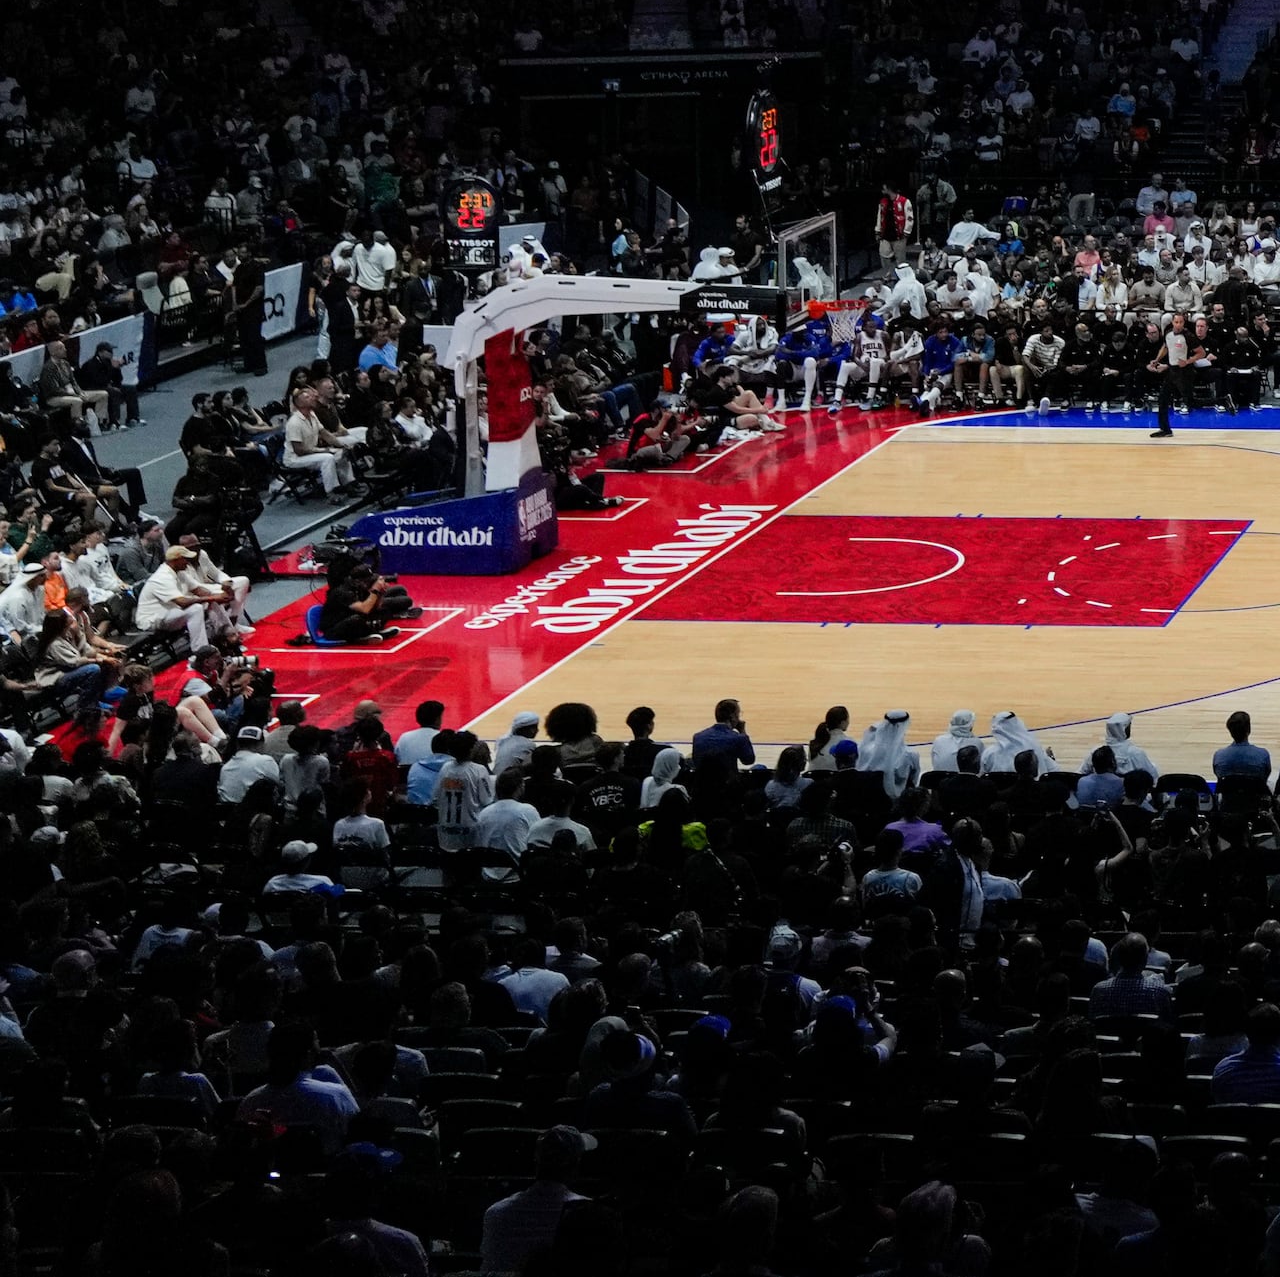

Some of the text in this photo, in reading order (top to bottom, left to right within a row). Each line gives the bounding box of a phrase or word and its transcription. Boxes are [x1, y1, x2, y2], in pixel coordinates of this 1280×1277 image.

[760, 128, 777, 167] 22
[460, 192, 492, 209] 2:37
[457, 207, 486, 228] 22
[461, 239, 495, 247] TISSOT
[697, 299, 722, 310] abu
[379, 526, 424, 546] abu
[530, 578, 668, 634] abu
